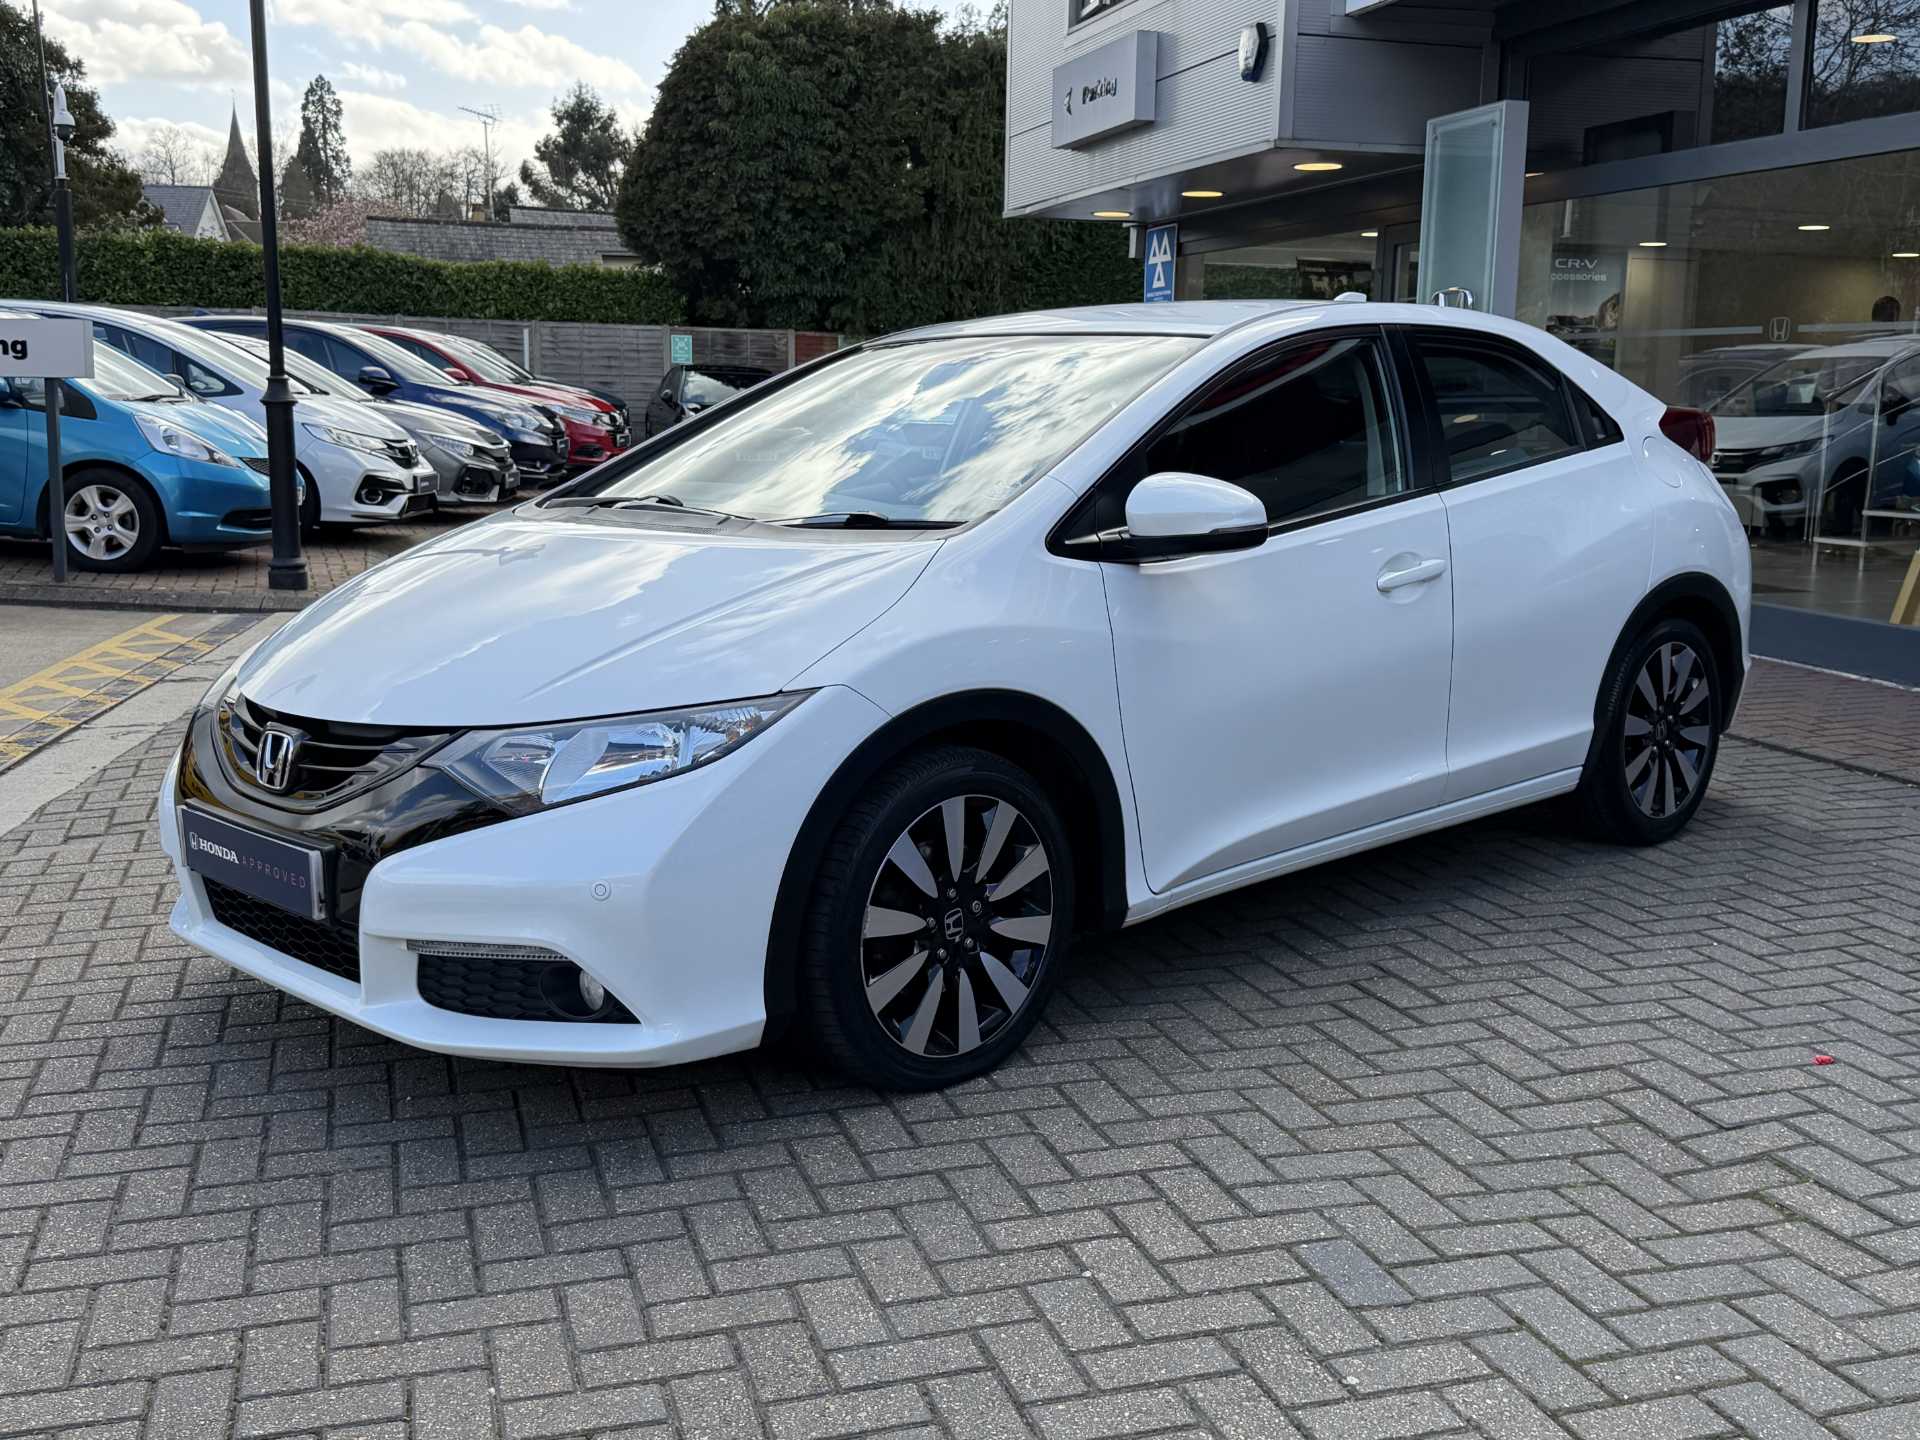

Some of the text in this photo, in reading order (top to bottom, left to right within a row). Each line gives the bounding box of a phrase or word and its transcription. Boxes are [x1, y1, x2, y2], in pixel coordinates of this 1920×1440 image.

[1555, 258, 1598, 269] CR-V
[199, 838, 306, 888] HONDA APPROVED
